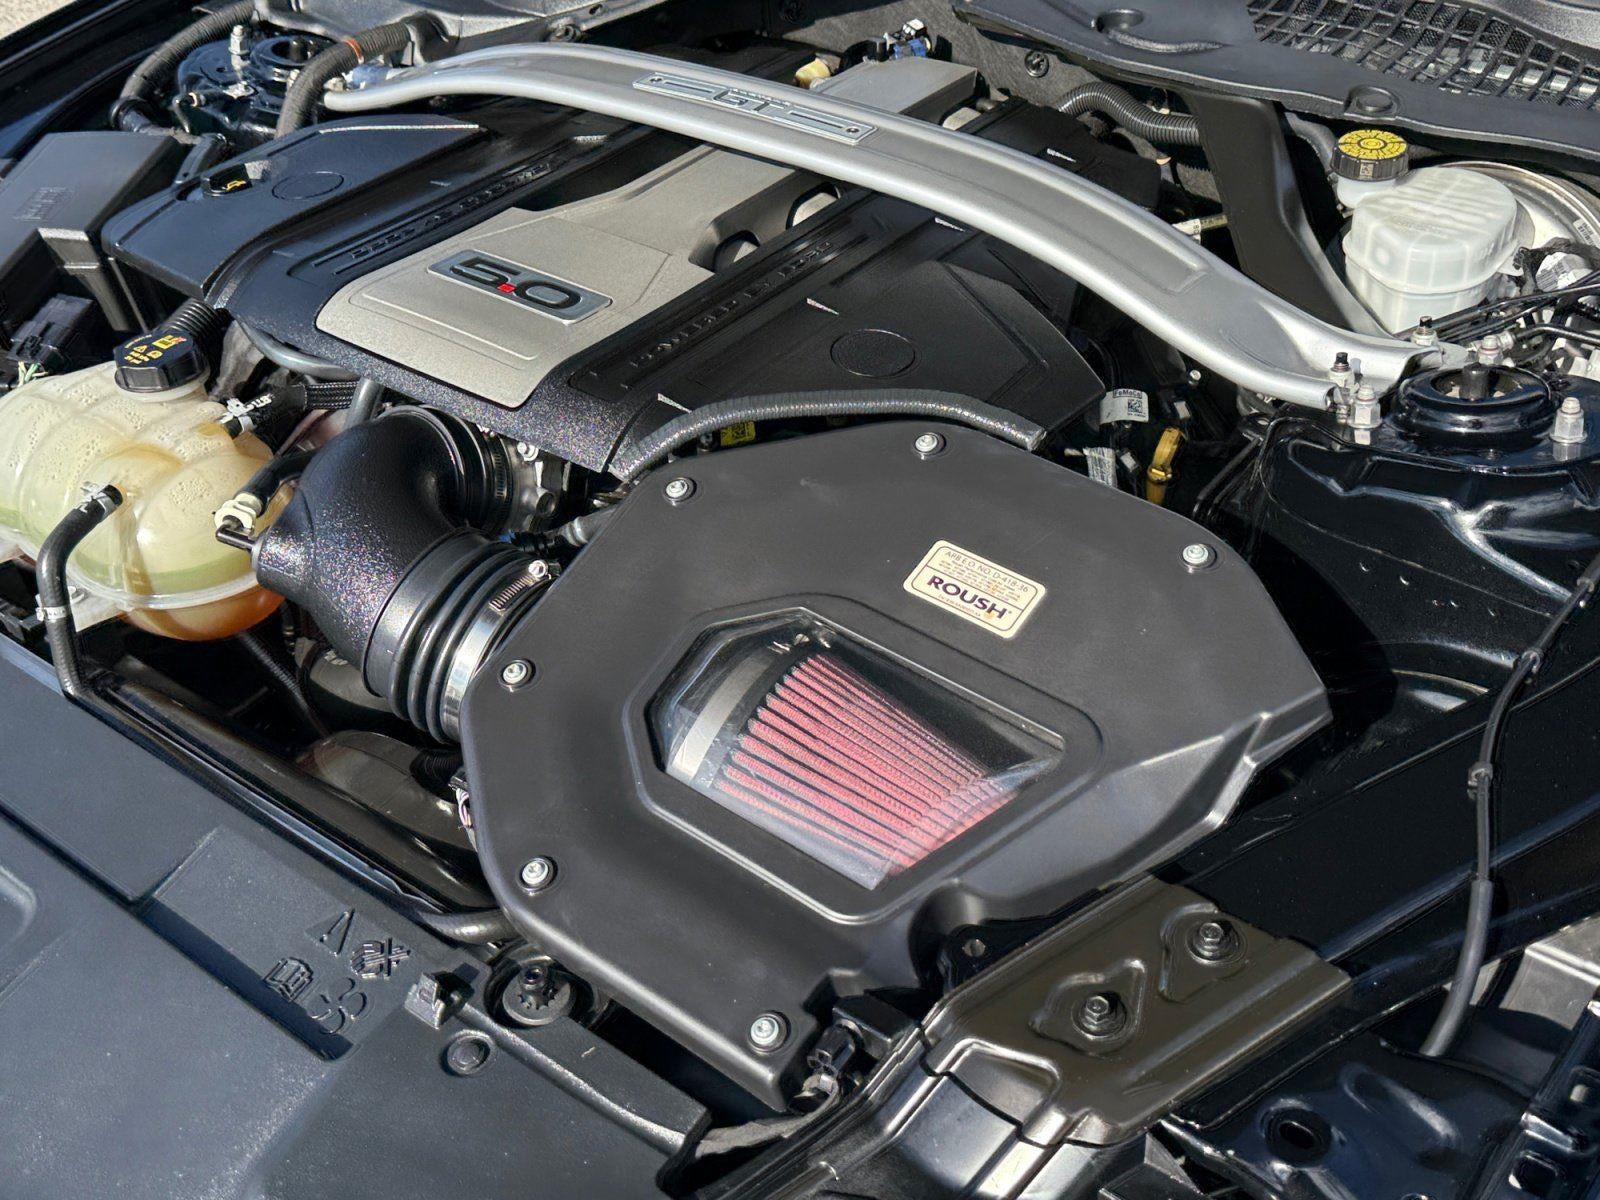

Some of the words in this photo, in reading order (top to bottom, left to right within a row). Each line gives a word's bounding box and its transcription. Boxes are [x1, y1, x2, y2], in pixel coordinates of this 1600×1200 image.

[713, 89, 788, 112] GT
[449, 256, 583, 309] 5.0
[927, 575, 1007, 619] ROUSH
